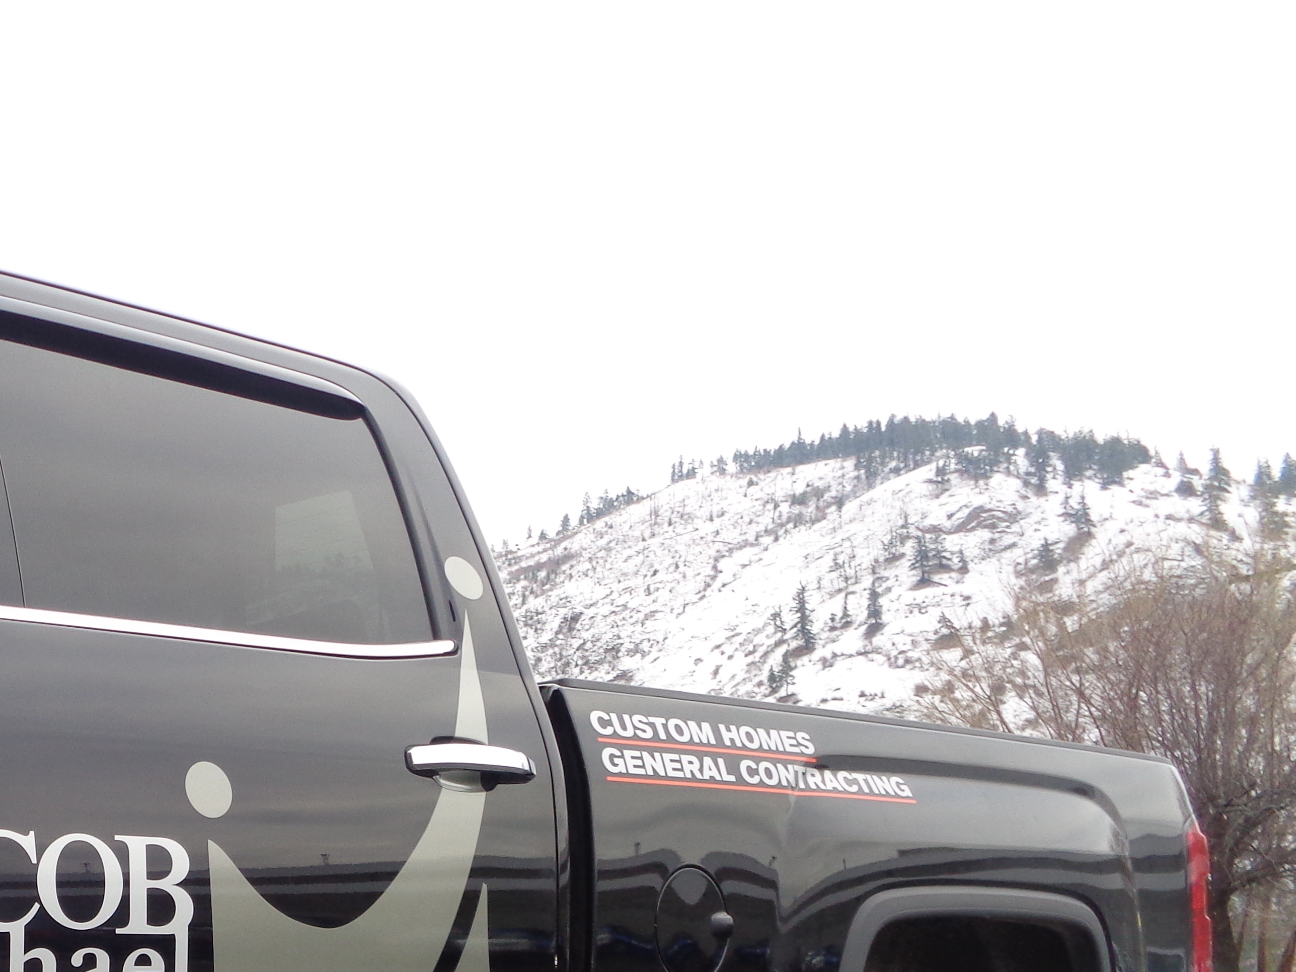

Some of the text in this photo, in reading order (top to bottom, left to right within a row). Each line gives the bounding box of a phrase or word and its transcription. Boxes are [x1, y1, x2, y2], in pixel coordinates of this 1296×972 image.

[589, 710, 815, 755] CUSTOM HOMES
[601, 747, 913, 797] GENERAL CONTRACTING
